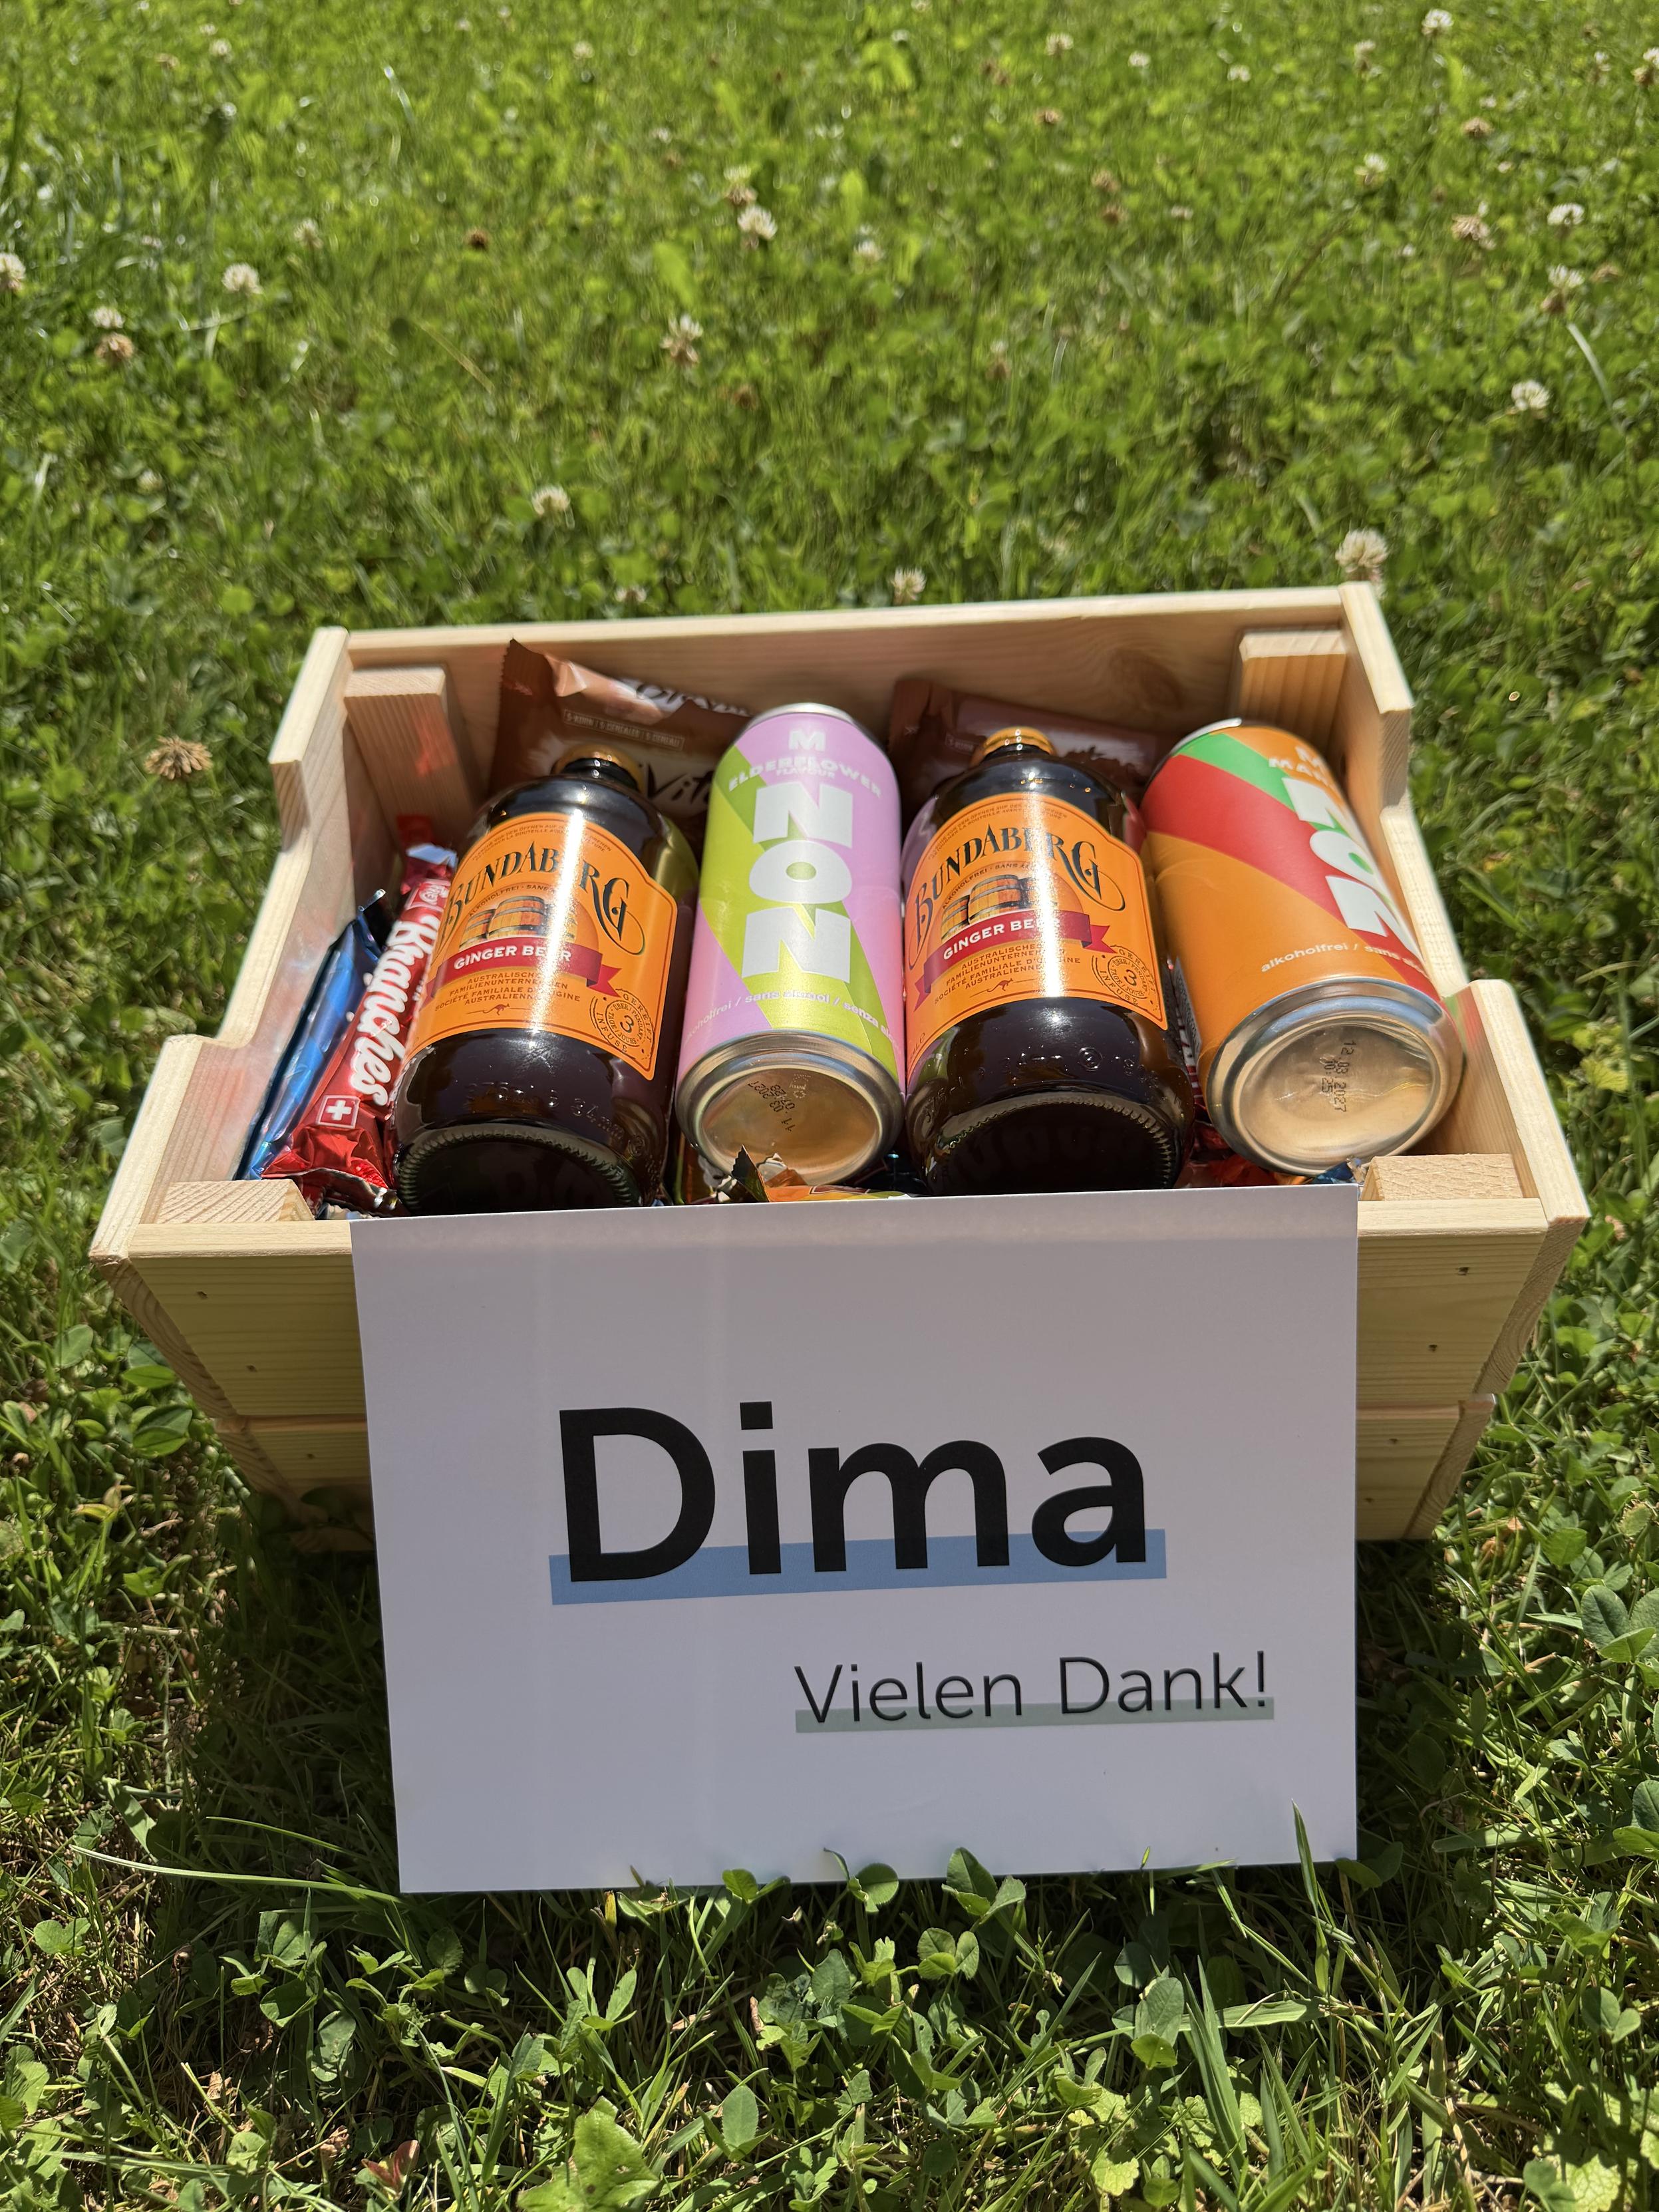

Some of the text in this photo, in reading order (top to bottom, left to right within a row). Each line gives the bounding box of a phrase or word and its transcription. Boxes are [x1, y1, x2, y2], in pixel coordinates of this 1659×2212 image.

[728, 756, 882, 798] ELDERFLOWER
[431, 841, 645, 965] BUNDABRG
[469, 885, 520, 917] ALKOHOLFREI
[943, 868, 988, 909] ALKOHOLFREI
[943, 917, 1060, 961] GINGER BE
[454, 945, 572, 970] GINGER BER
[946, 949, 1065, 986] FAMILIENUNTERNEHN
[970, 960, 1022, 981] FAMILIALE
[1261, 942, 1349, 973] alkoholfrei
[1364, 945, 1400, 961] sans
[449, 979, 568, 997] FAMILIENUNTERNEEN
[468, 972, 539, 984] AUSTRALISCH
[1124, 969, 1137, 987] 3
[350, 915, 440, 1106] Branches
[464, 993, 534, 1006] AUSTRALIENN
[471, 987, 524, 998] FAMILIALE
[528, 987, 581, 1002] DIGINE
[744, 991, 780, 1003] sans
[842, 1002, 879, 1028] senza
[619, 1015, 634, 1032] 3
[559, 1400, 1146, 1583] Dima
[794, 1650, 1266, 1724] Vielen Dank!
